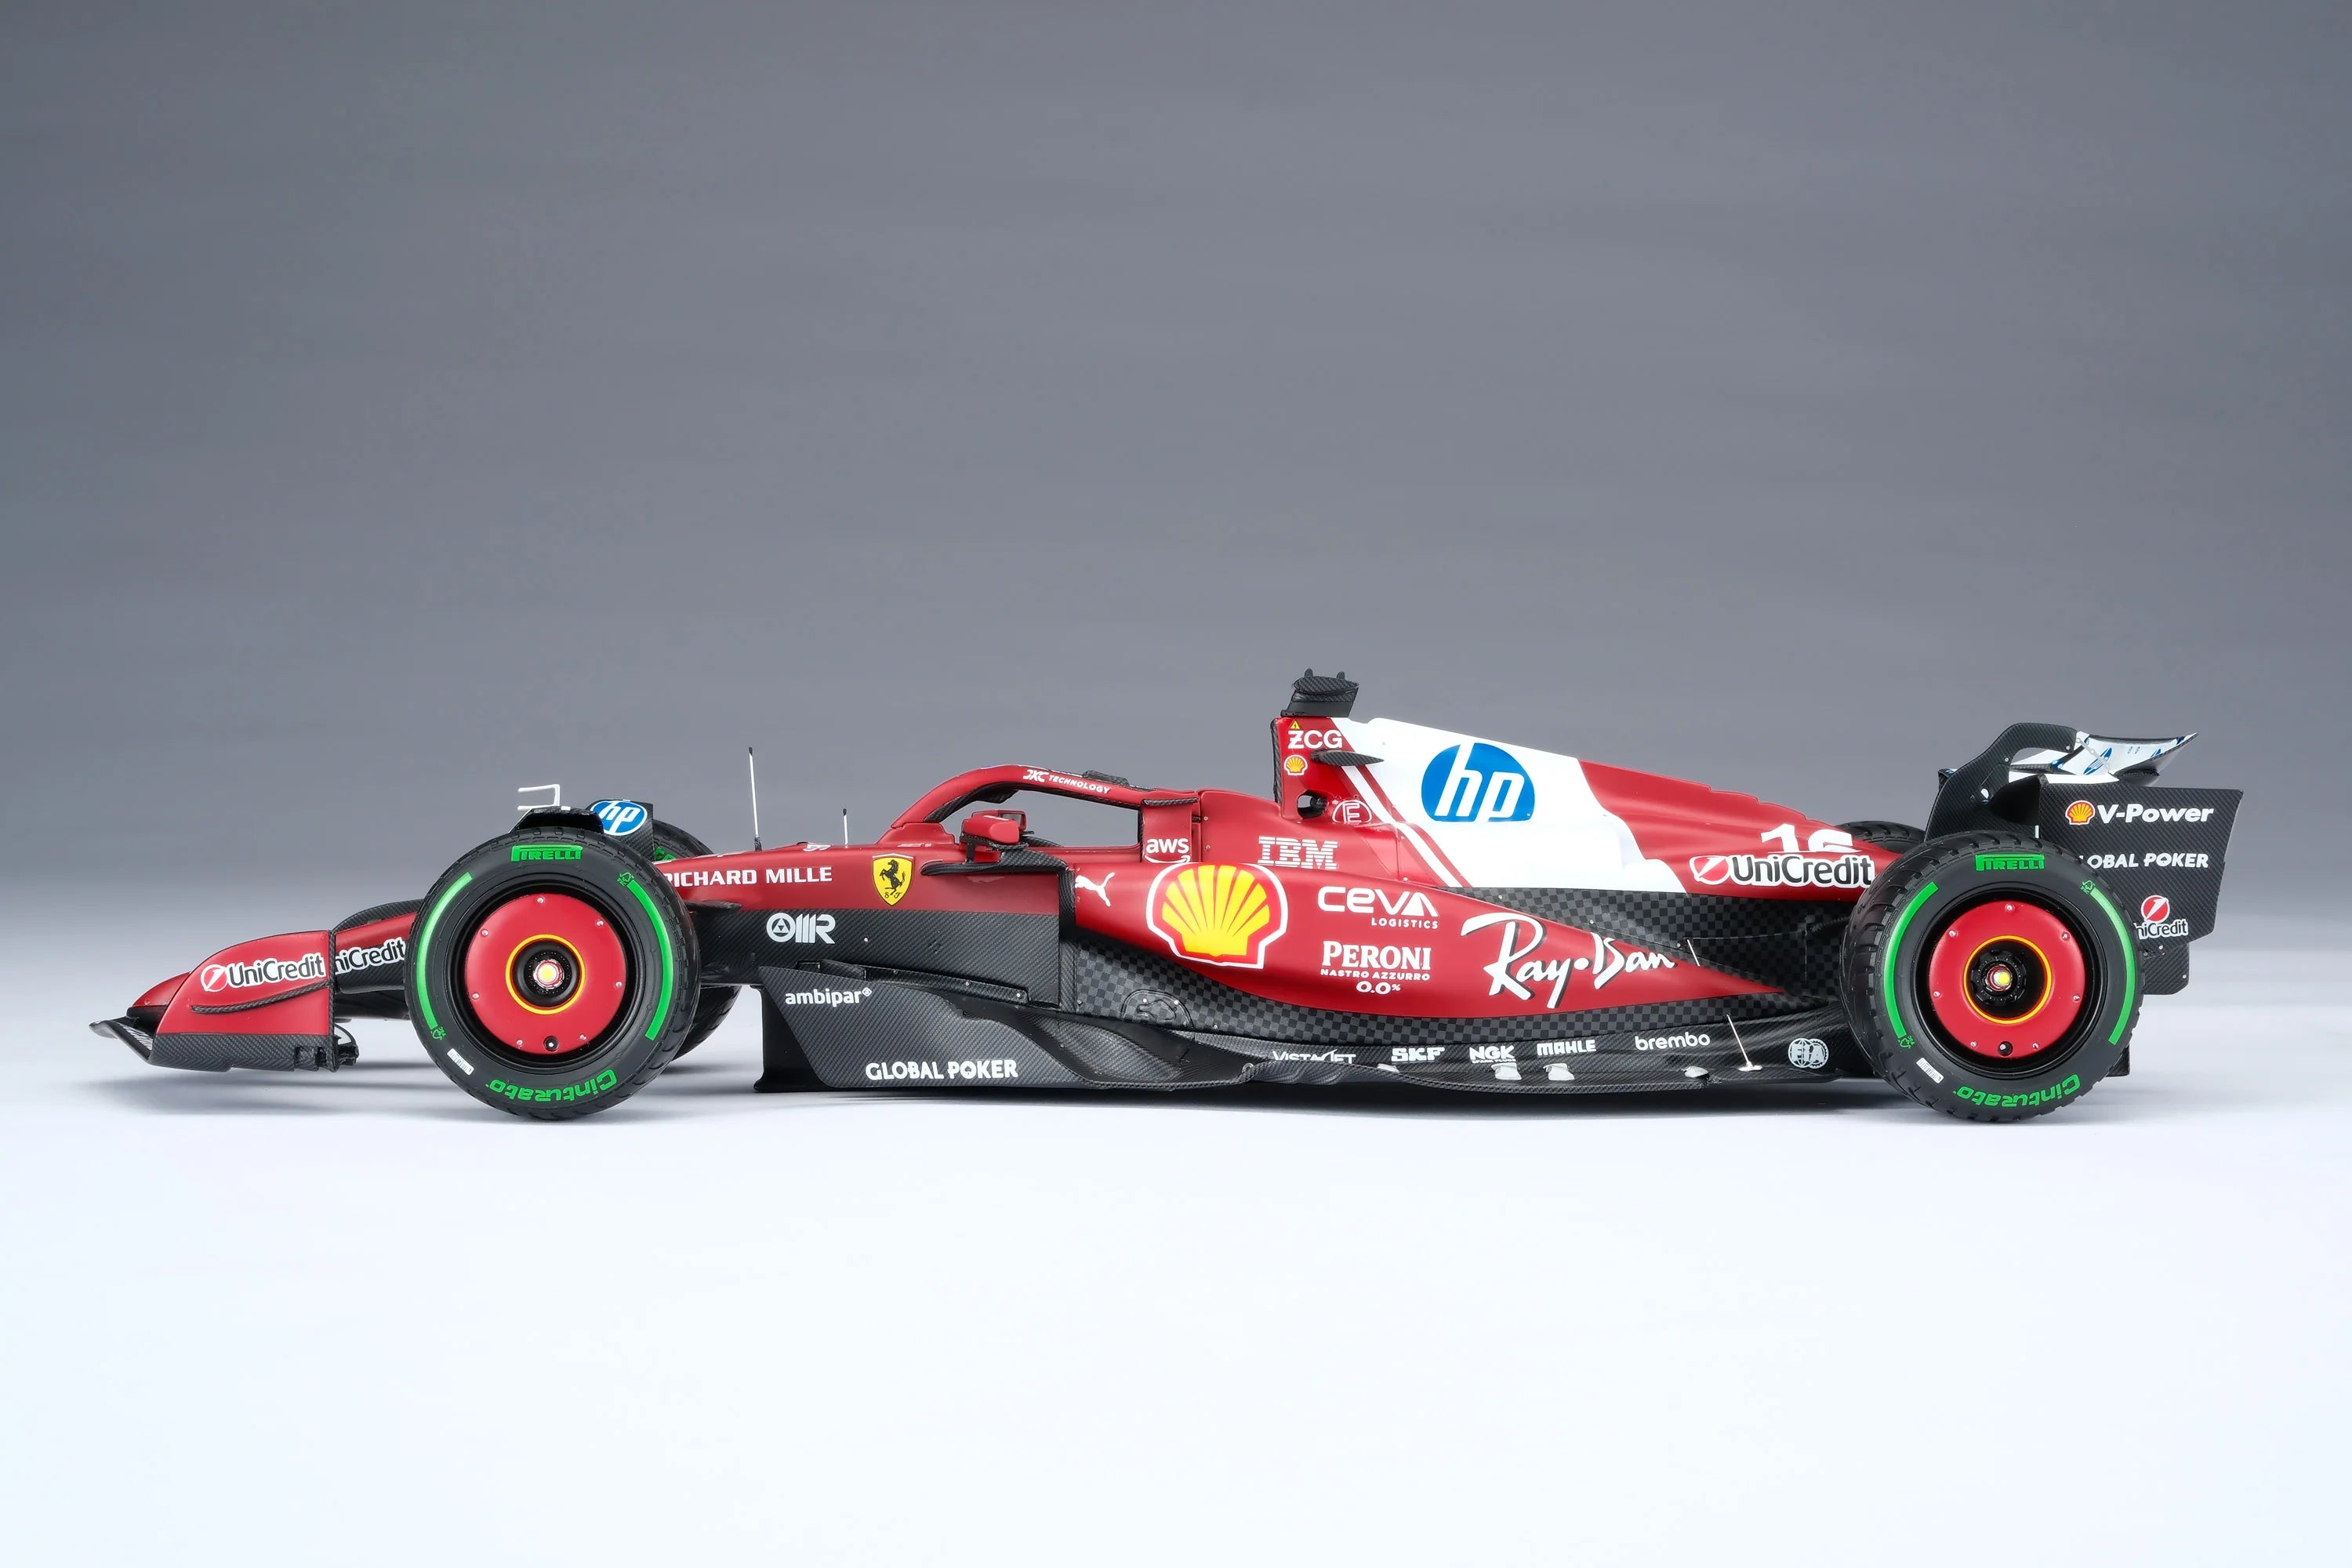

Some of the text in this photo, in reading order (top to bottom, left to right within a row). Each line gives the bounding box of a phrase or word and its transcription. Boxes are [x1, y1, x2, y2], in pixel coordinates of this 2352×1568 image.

[1048, 774, 1112, 794] TECHNOLOGY
[1435, 742, 1525, 822] hp
[598, 800, 641, 833] hp
[1342, 802, 1362, 825] E
[2097, 804, 2214, 823] V-Power
[511, 844, 583, 862] PIRELLI
[1145, 837, 1189, 855] aws
[1258, 836, 1338, 870] IBM
[1732, 855, 1872, 885] UniCredit
[1975, 854, 2045, 871] PIRELLI
[2079, 852, 2209, 869] OBAL POKER
[765, 866, 833, 884] MILLE
[1370, 916, 1439, 930] LOGISTICS
[2136, 920, 2187, 937] niCredit
[334, 939, 405, 972] niCredit
[1322, 940, 1432, 971] PERONI
[228, 954, 325, 987] UniCredit
[1320, 967, 1431, 981] NASTRO AZZURRO
[1356, 980, 1401, 995] 0.0%
[785, 988, 862, 1007] ambipar
[1537, 1039, 1597, 1056] MAHLE
[1634, 1031, 1711, 1051] brembo
[1391, 1047, 1446, 1062] SKF
[1468, 1044, 1515, 1060] NGK
[864, 1058, 1019, 1081] GLOBAL POKER
[488, 1069, 618, 1102] Cinturato
[1956, 1073, 2082, 1108] Cinturato
